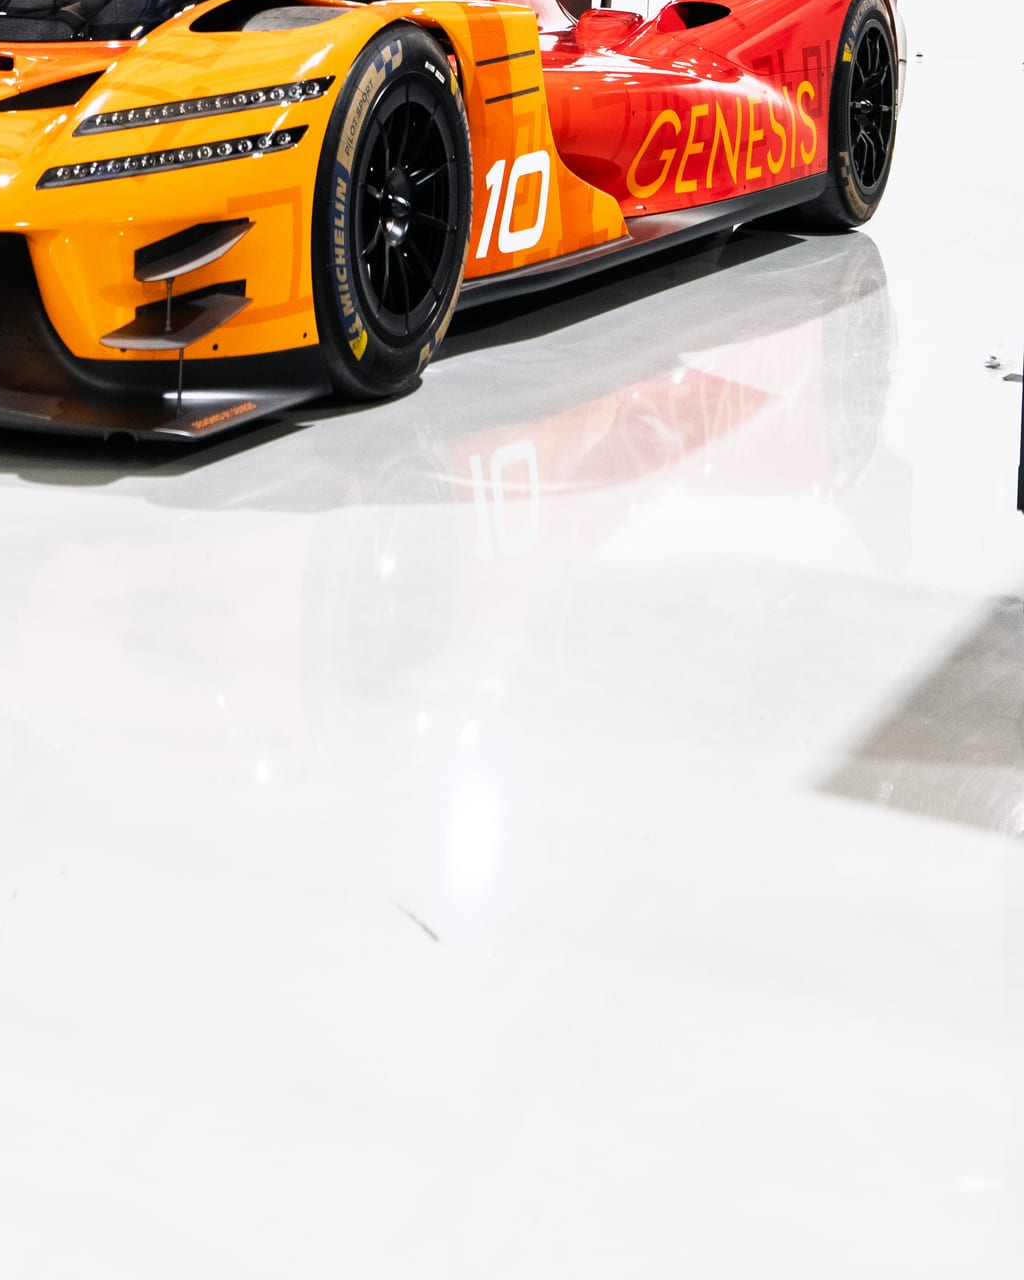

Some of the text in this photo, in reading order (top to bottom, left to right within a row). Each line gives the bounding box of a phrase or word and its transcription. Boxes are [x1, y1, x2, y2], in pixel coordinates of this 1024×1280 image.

[344, 79, 375, 158] PILOT SPORT
[626, 80, 818, 199] GENESIS
[334, 176, 355, 317] MICHELIN
[475, 149, 551, 259] 10
